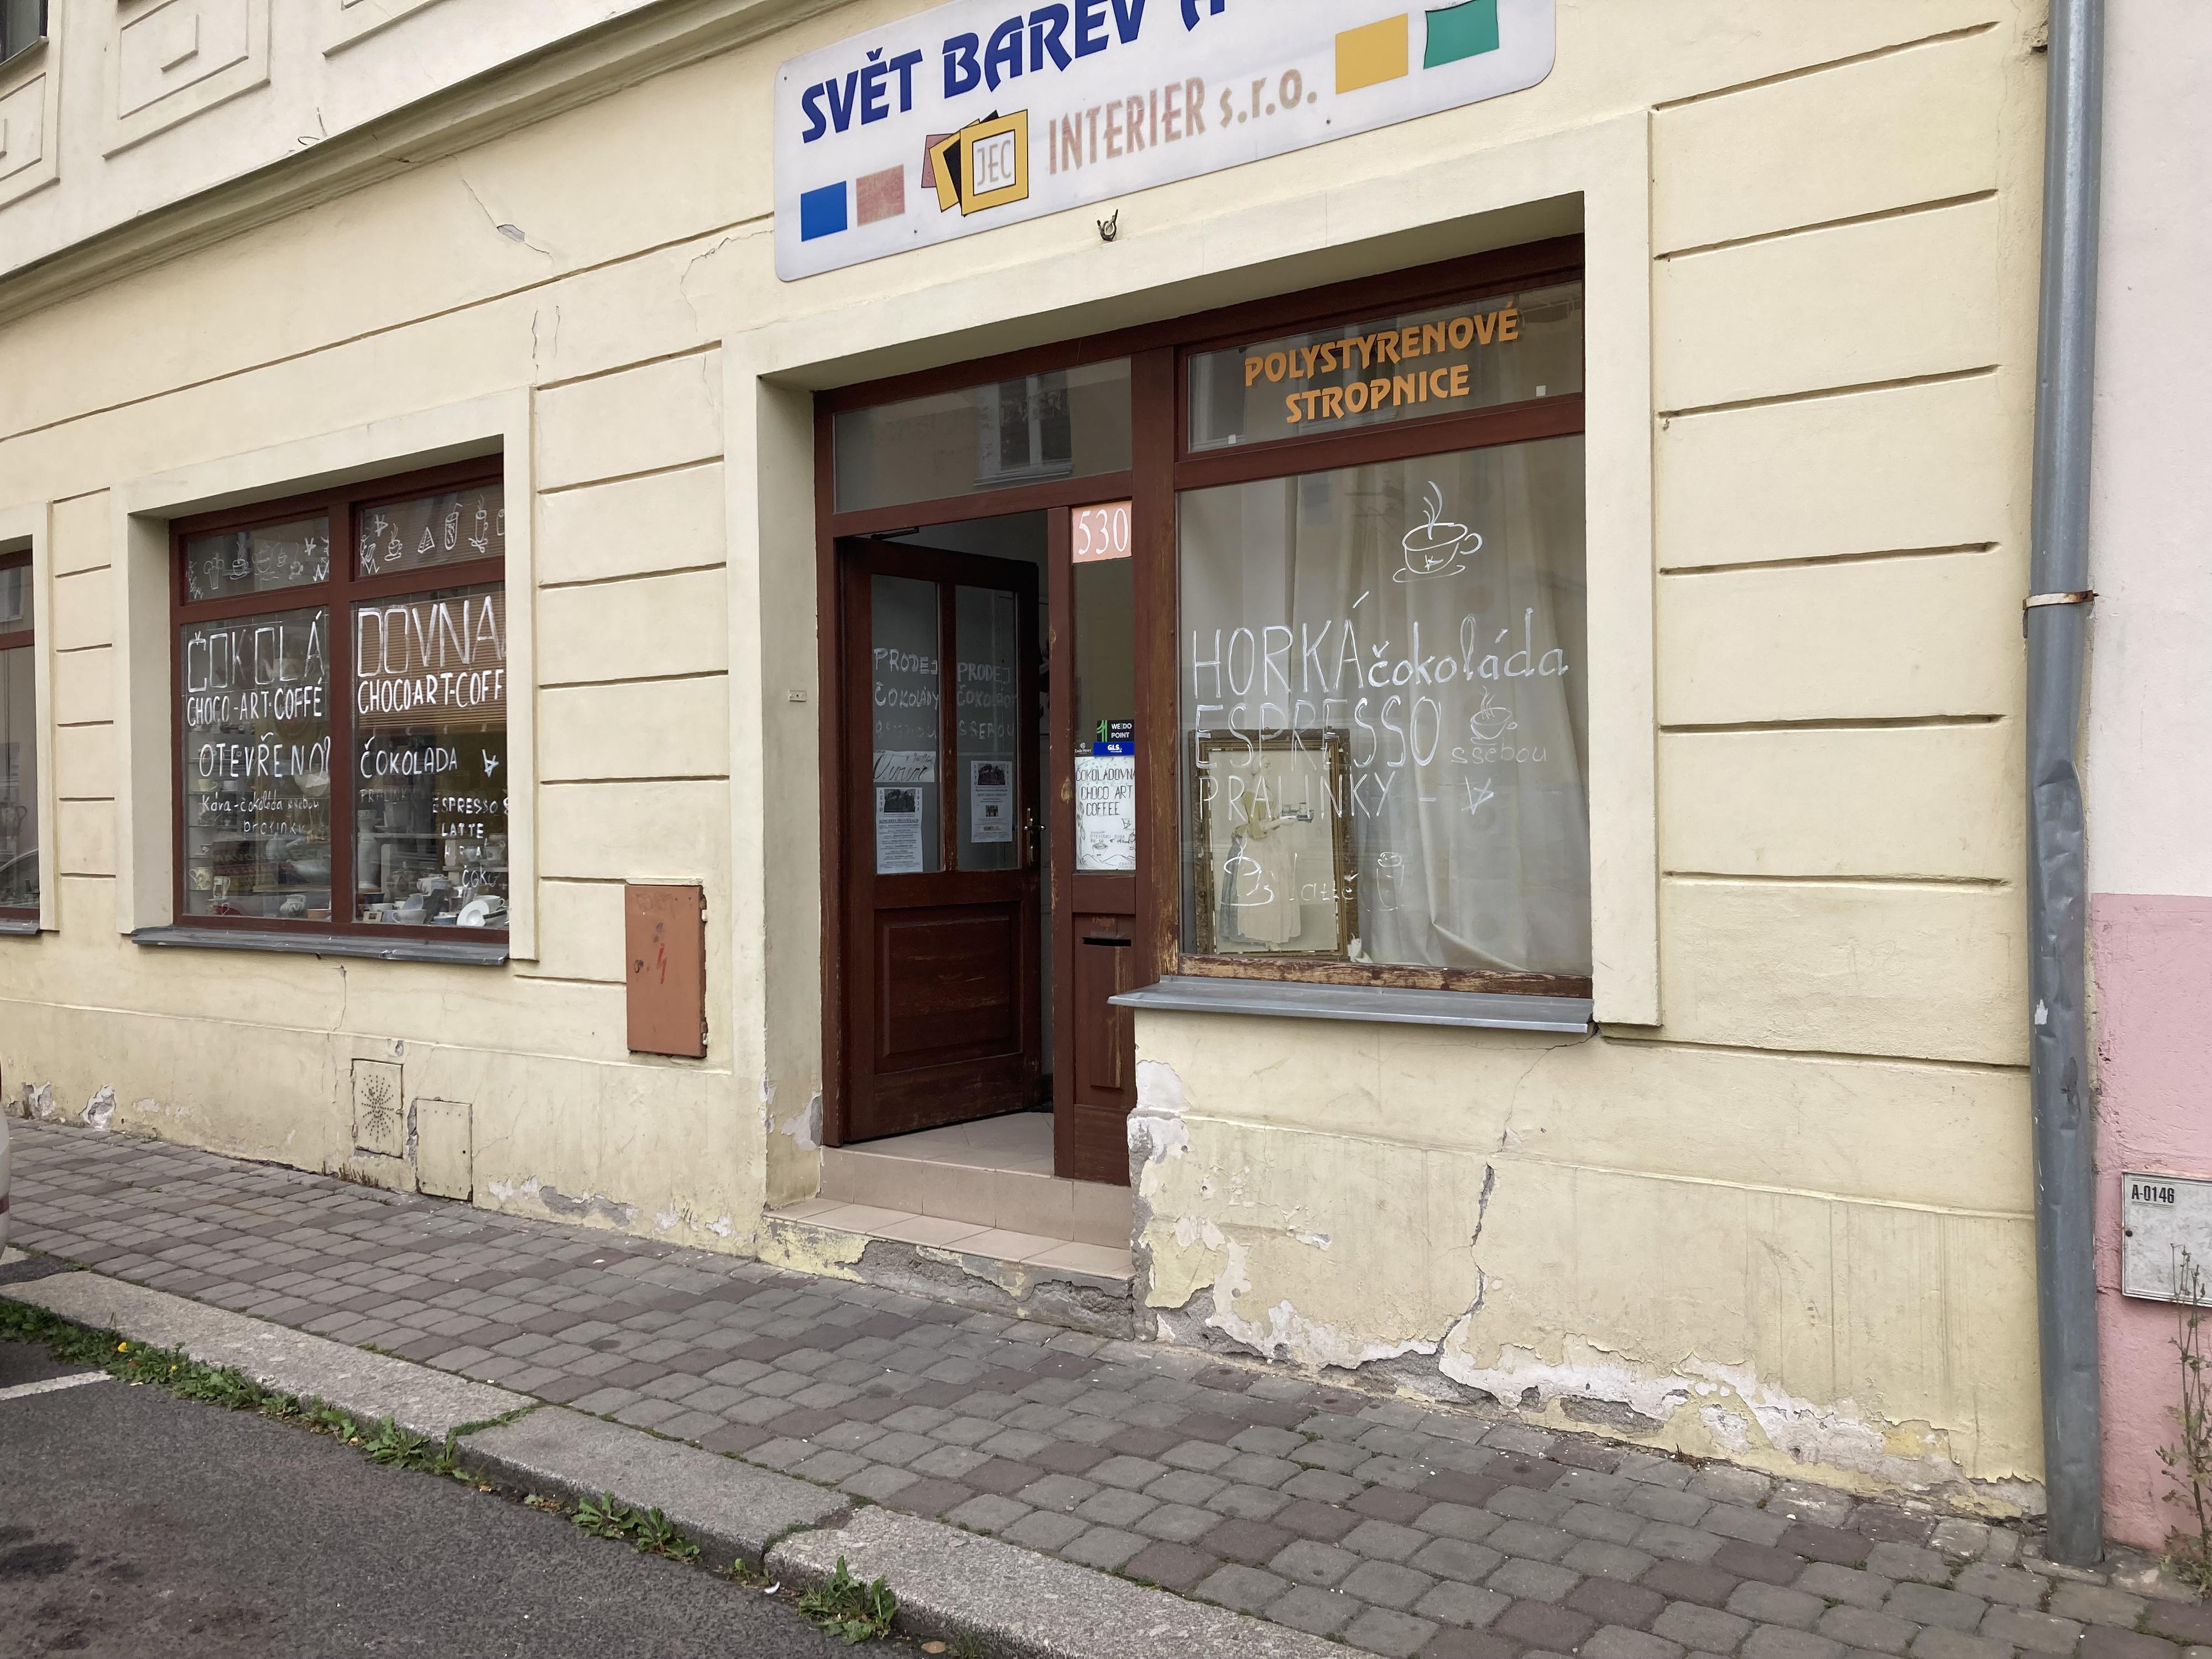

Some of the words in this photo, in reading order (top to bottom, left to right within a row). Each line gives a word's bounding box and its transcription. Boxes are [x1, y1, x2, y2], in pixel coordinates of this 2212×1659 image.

[802, 47, 923, 143] SVĚT
[942, 0, 1145, 98] BAREV
[1049, 76, 1206, 175] INTERIER
[1219, 68, 1318, 128] s.r.o.
[977, 139, 1011, 186] JEC
[1244, 301, 1519, 387] POLYSTYRENOVÉ
[1285, 364, 1470, 424] STROPNICE
[1078, 508, 1128, 555] 530
[874, 648, 937, 675] PRODEJ
[1192, 591, 1370, 699] HORKÁ
[1368, 607, 1569, 688] čokoláda
[957, 662, 1010, 685] PRODEJ
[1195, 695, 1442, 771] ESPRESSO
[432, 797, 498, 815] ESPRESSO
[1081, 786, 1109, 800] CHOCO
[1115, 785, 1133, 799] ART
[1086, 802, 1121, 816] COFFEE
[1198, 771, 1396, 822] PRALINKY
[442, 822, 484, 839] LATTE
[2132, 1184, 2174, 1204] A-0146
